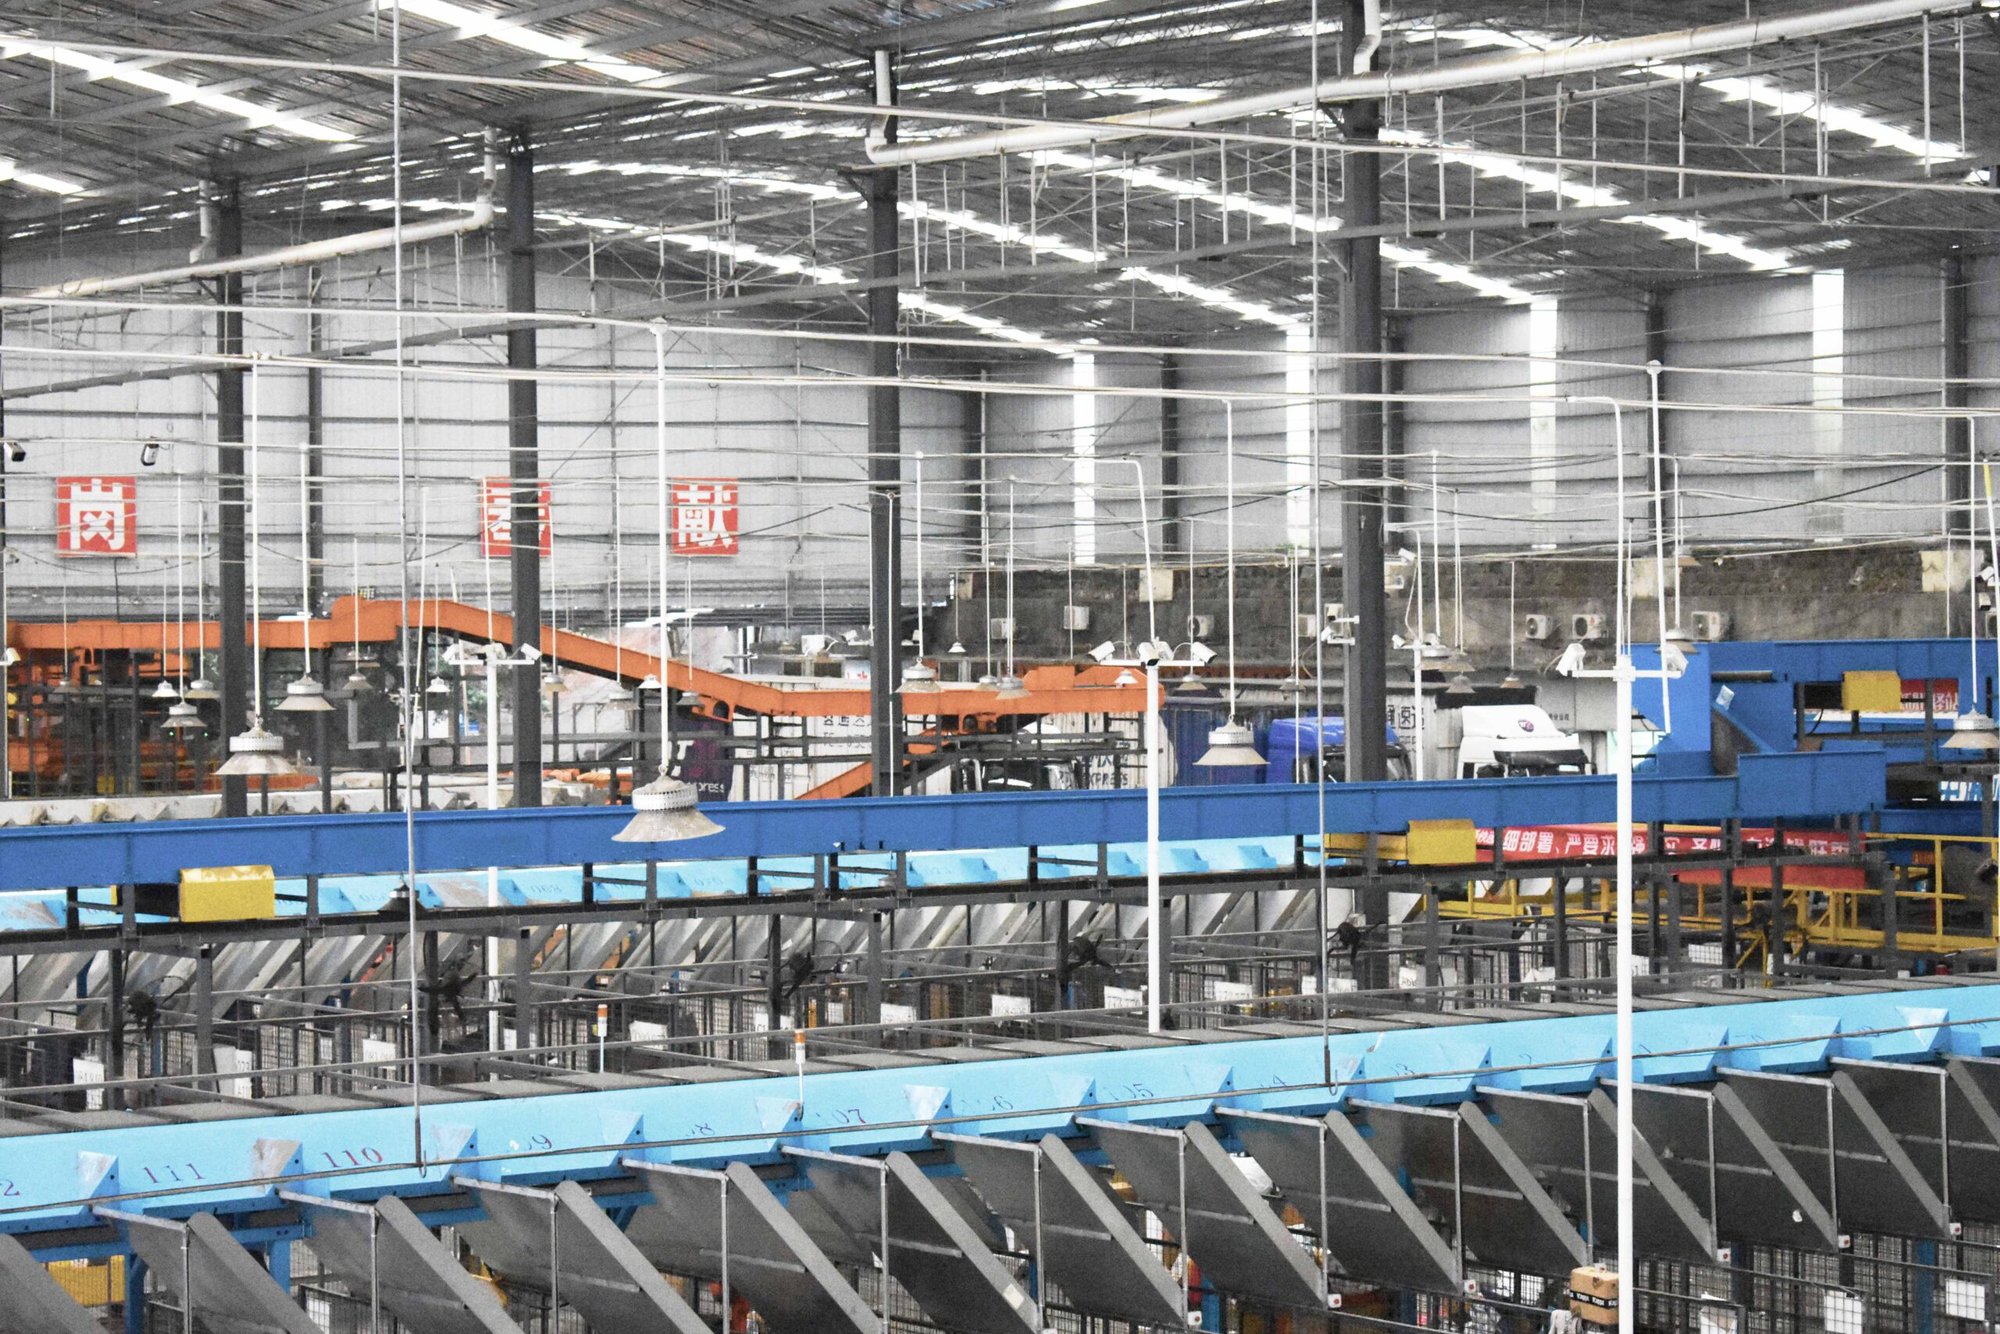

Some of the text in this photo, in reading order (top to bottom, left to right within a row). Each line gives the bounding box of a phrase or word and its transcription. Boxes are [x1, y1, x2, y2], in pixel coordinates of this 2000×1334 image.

[70, 478, 125, 550] 岗
[676, 482, 735, 548] 献
[142, 1163, 205, 1184] 111
[321, 1146, 383, 1168] 110
